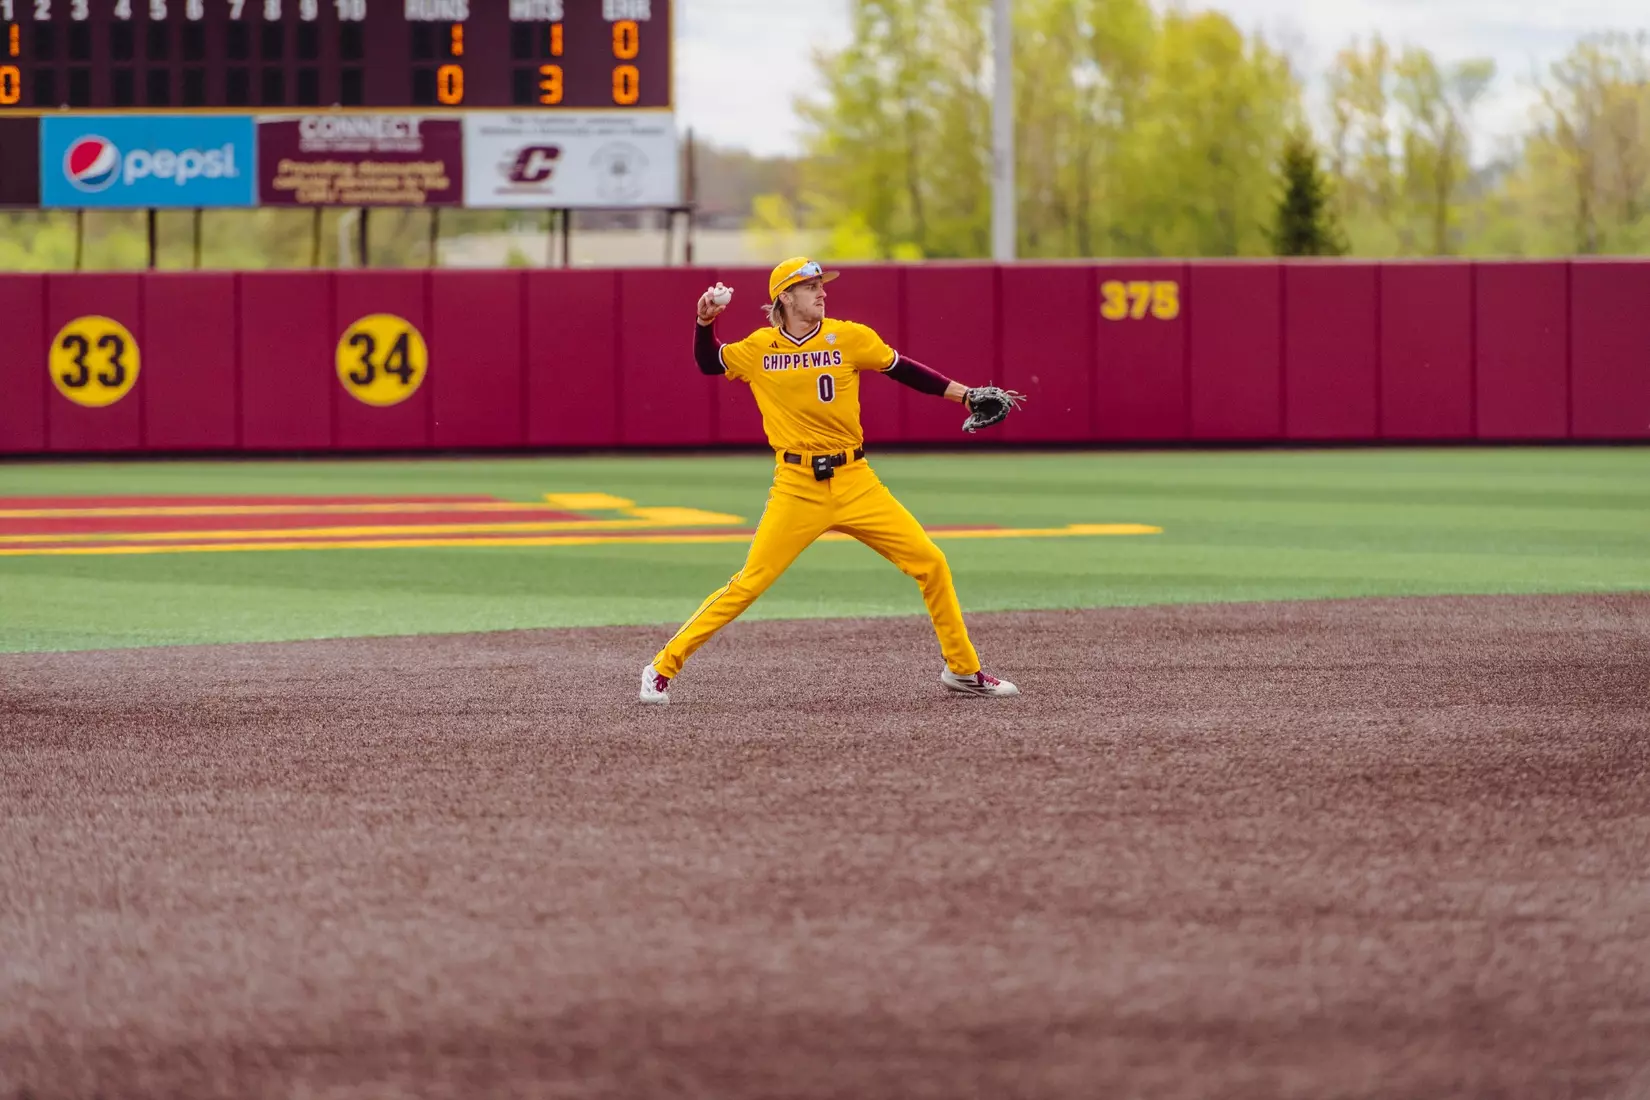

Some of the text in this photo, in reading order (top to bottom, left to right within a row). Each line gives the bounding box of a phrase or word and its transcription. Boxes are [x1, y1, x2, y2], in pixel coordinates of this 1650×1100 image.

[2, 0, 14, 21] 1
[34, 0, 51, 21] 2
[70, 0, 90, 21] 3
[114, 0, 132, 21] 4
[149, 0, 168, 21] 5
[185, 0, 204, 21] 6
[227, 0, 245, 21] 7
[263, 0, 282, 21] 8
[299, 0, 318, 21] 9
[334, 0, 366, 21] 10
[404, 0, 469, 21] RUNS
[509, 0, 563, 21] HITS
[9, 19, 639, 59] 1 1 1 0
[0, 64, 639, 104] 0 0 3 0
[299, 115, 421, 138] CONNECT
[123, 142, 236, 186] pepsi
[1100, 279, 1180, 320] 375
[61, 334, 126, 389] 33
[348, 332, 415, 387] 34
[762, 349, 843, 371] CHIPPEWAS
[816, 373, 836, 404] 0
